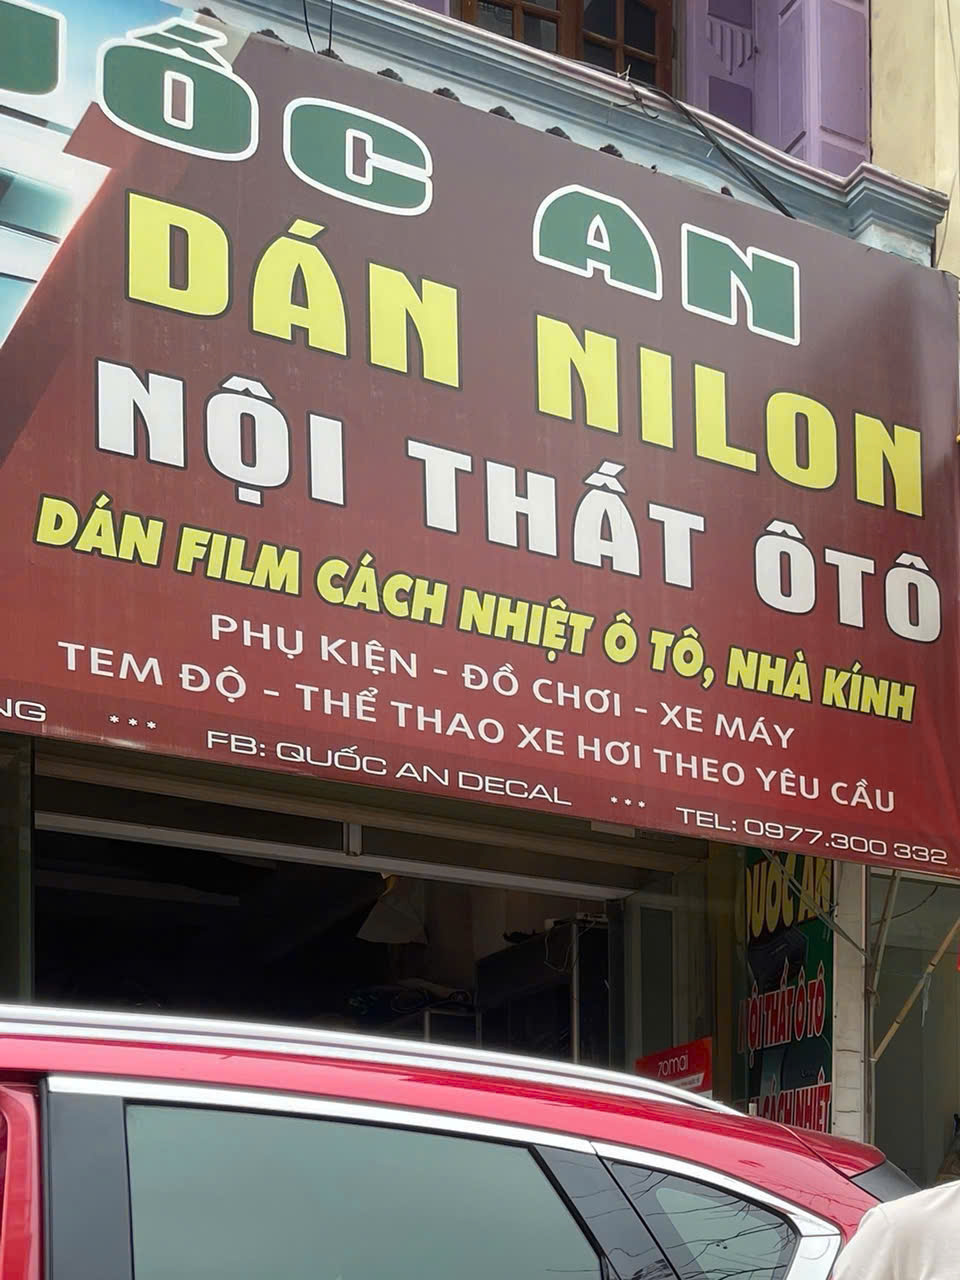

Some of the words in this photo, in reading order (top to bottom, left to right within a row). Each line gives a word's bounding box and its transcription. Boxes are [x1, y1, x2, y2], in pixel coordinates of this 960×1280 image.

[533, 184, 800, 346] AN
[127, 191, 460, 389] DÁN
[536, 314, 924, 518] NILON
[97, 359, 345, 506] NỘI
[407, 439, 705, 590] THẤT
[755, 518, 942, 644] ÔTÔ
[35, 494, 164, 567] DÁN
[175, 525, 301, 596] FILM
[315, 553, 449, 627] CÁCH
[459, 587, 594, 663] NHIỆT
[602, 611, 638, 664] Ô
[649, 625, 716, 690] TÔ,
[726, 646, 812, 702] NHÀ
[820, 661, 916, 723] KÍNH
[210, 613, 304, 660] PHỤ
[319, 634, 418, 678] KIỆN
[462, 661, 520, 698] ĐỒ
[532, 678, 621, 718] CHƠI
[659, 701, 704, 734] XE
[714, 713, 796, 750] MÁY
[57, 640, 164, 687] TEM
[178, 663, 247, 704] ĐỘ
[295, 682, 378, 724] THỂ
[390, 699, 505, 745] THAO
[516, 724, 565, 757] XE
[576, 733, 641, 770] HƠI
[653, 747, 745, 787] THEO
[754, 765, 820, 801] YÊU
[830, 777, 896, 814] CẦU
[206, 731, 267, 758] FB:
[275, 743, 388, 777] QUỐC
[395, 762, 450, 787] AN
[458, 768, 573, 807] DECAL
[676, 806, 738, 833] TEL:
[743, 818, 887, 856] 0977.300
[892, 841, 949, 866] 332
